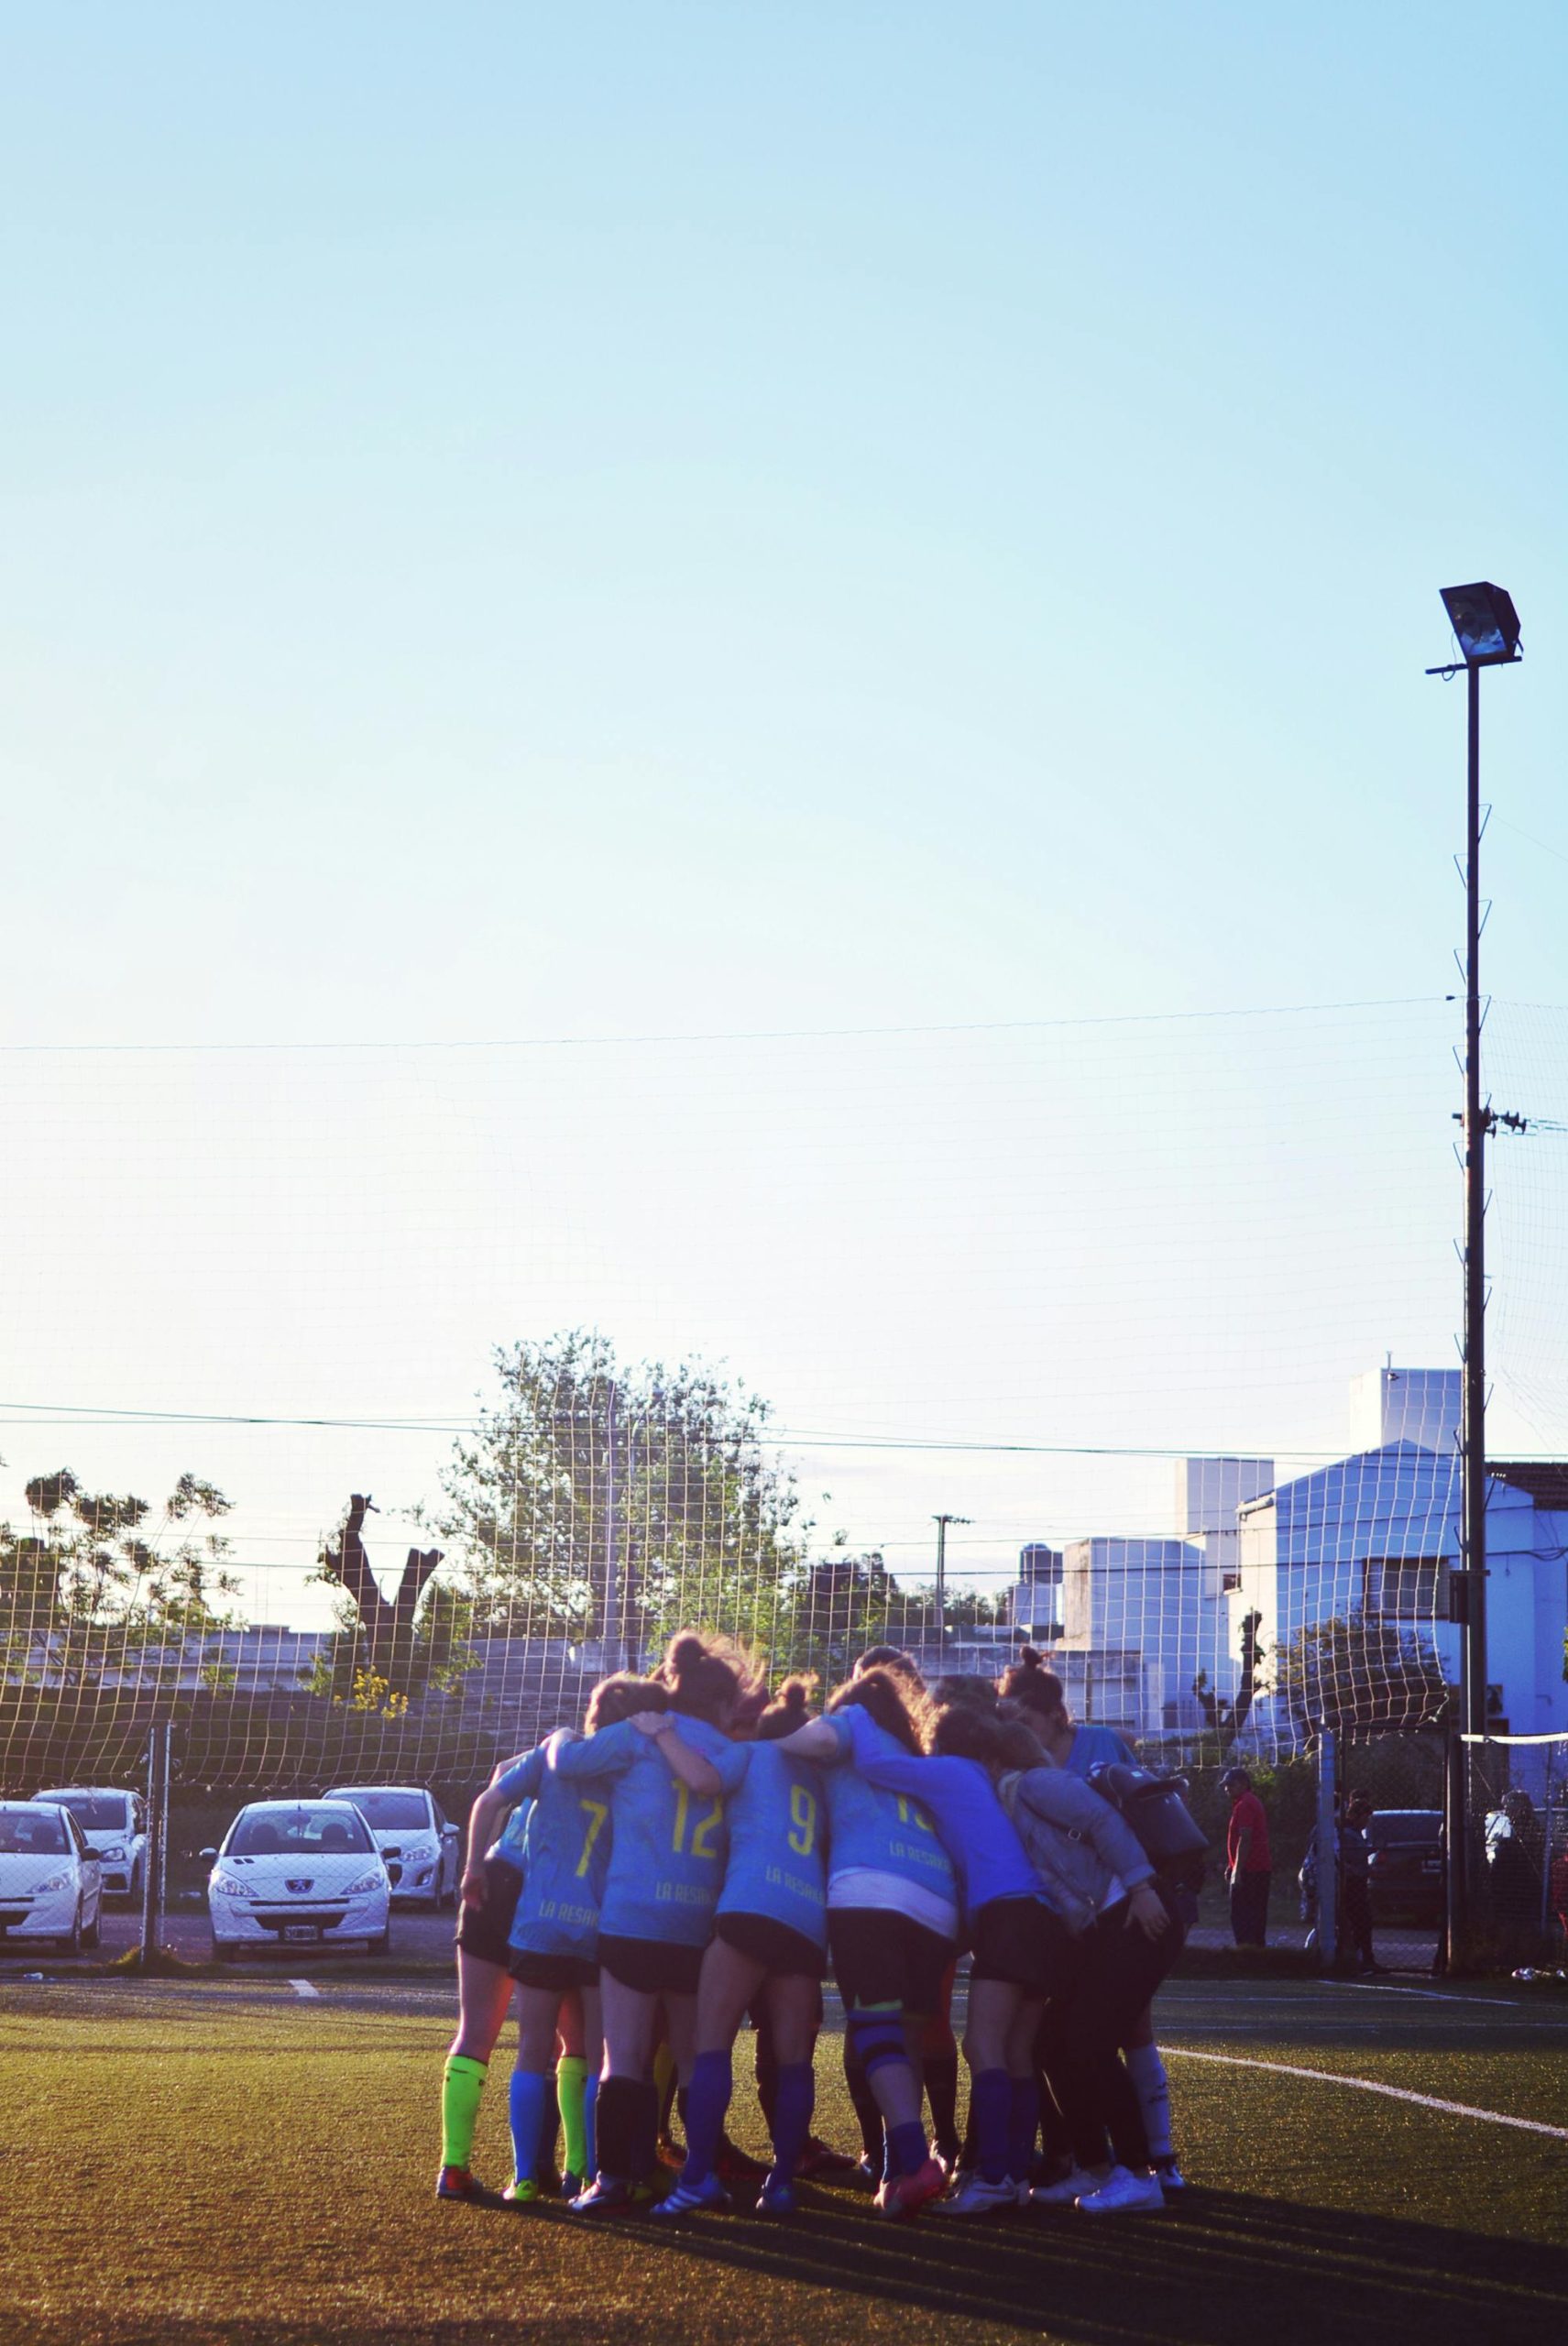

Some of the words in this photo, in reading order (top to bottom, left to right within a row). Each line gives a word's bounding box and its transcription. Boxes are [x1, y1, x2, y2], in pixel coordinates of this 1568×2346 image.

[672, 1779, 723, 1857] 12
[788, 1783, 817, 1856] 9
[576, 1799, 608, 1877] 7
[889, 1840, 905, 1858] LA
[766, 1866, 781, 1884] LA
[655, 1881, 672, 1901] LA
[539, 1900, 557, 1919] LA
